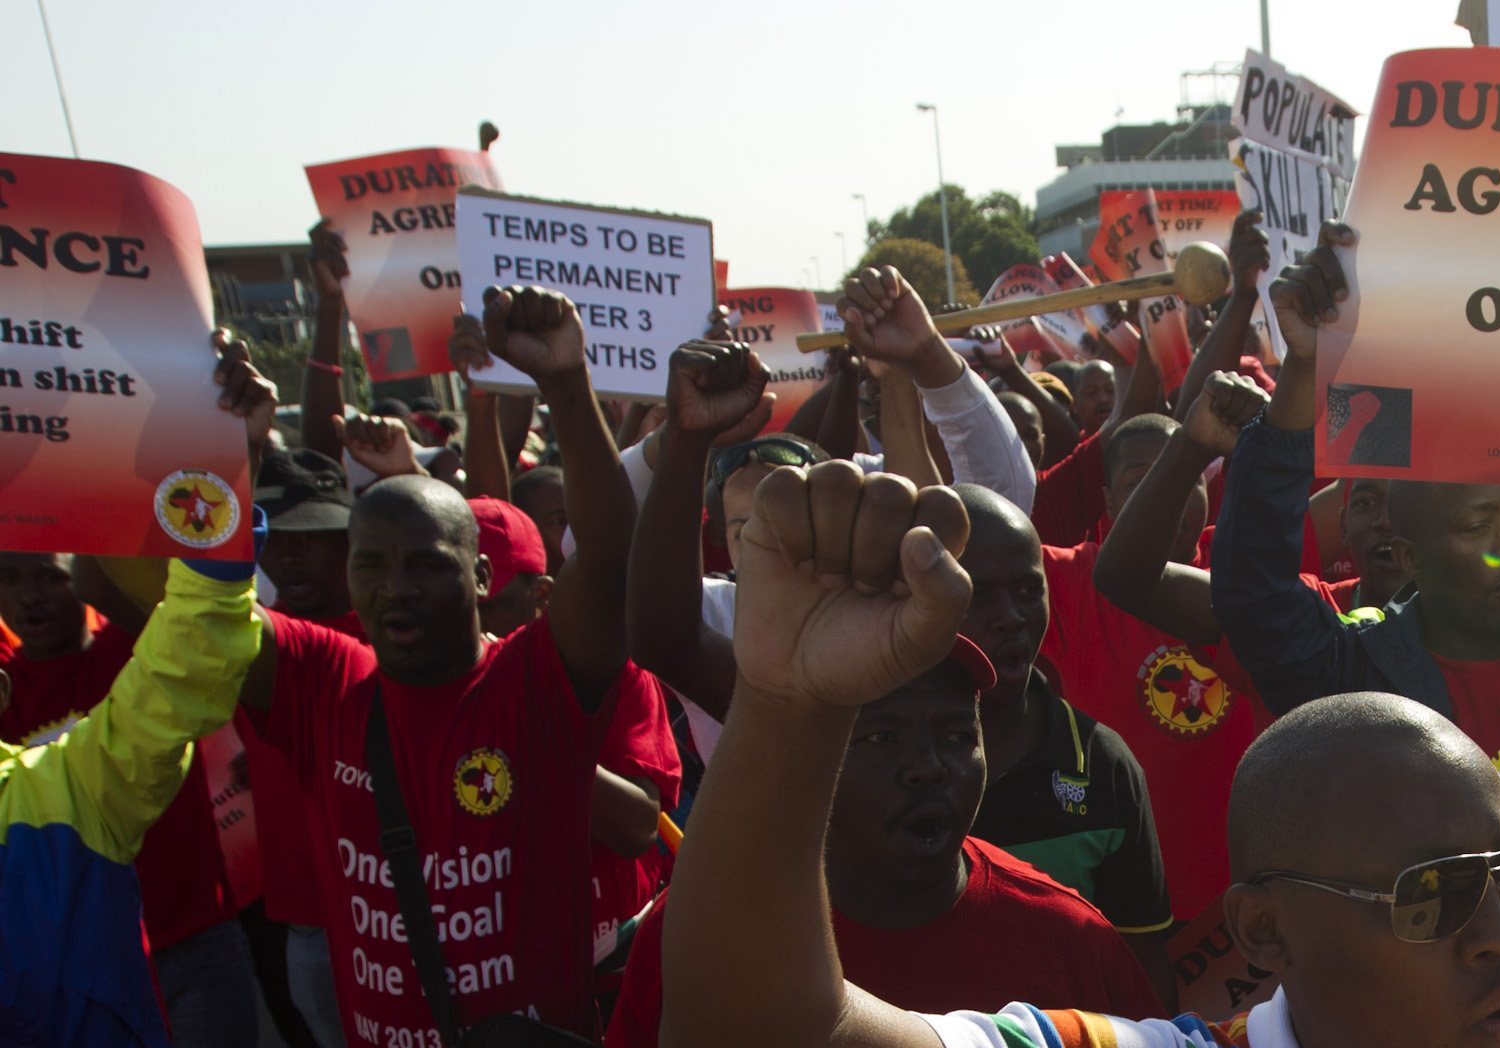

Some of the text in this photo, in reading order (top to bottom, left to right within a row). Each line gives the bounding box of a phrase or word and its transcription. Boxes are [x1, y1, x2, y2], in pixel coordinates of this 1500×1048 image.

[482, 212, 686, 259] TEMPS TO BE
[493, 254, 681, 297] PERMANENT
[637, 309, 653, 332] 3
[34, 365, 136, 397] shift
[337, 837, 396, 888] One
[351, 895, 409, 943] One
[353, 946, 405, 996] One
